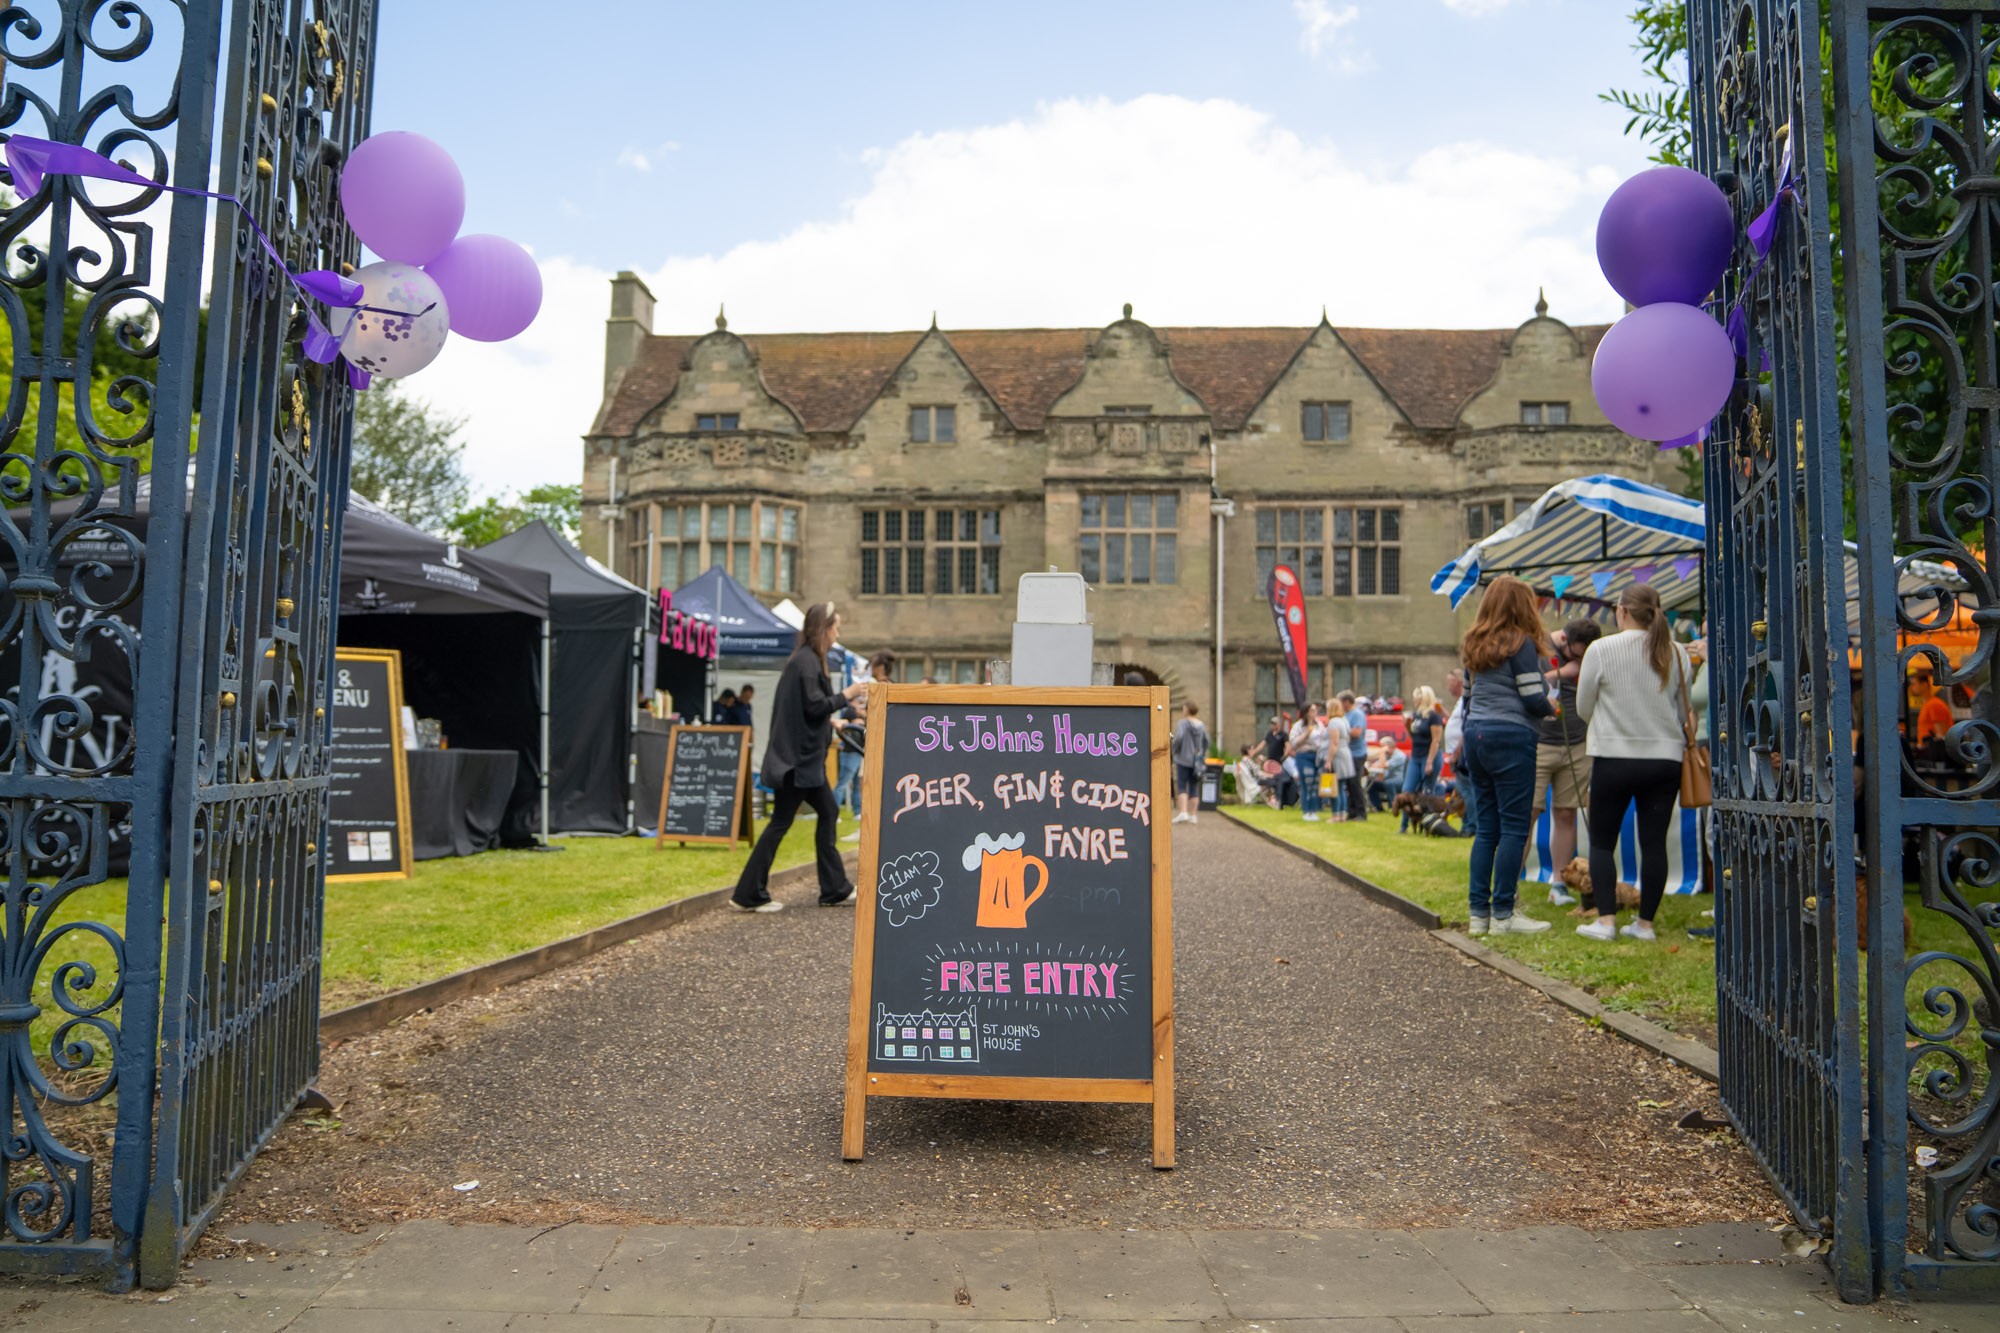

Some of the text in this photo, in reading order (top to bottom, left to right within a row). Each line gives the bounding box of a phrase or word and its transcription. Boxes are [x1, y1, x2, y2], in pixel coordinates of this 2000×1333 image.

[658, 587, 718, 660] Tacos
[338, 669, 353, 688] &
[333, 688, 370, 708] ENU
[914, 713, 1139, 757] St John's House
[893, 773, 985, 824] BEER,
[993, 770, 1047, 810] GIN
[1071, 779, 1151, 827] CIDER
[1044, 824, 1129, 866] FAYRE
[889, 865, 921, 890] 11AM
[893, 888, 923, 909] 7PM
[940, 961, 1119, 999] FREE ENTRY
[982, 1023, 1041, 1038] ST JOHN'S
[983, 1036, 1022, 1052] HOUSE
